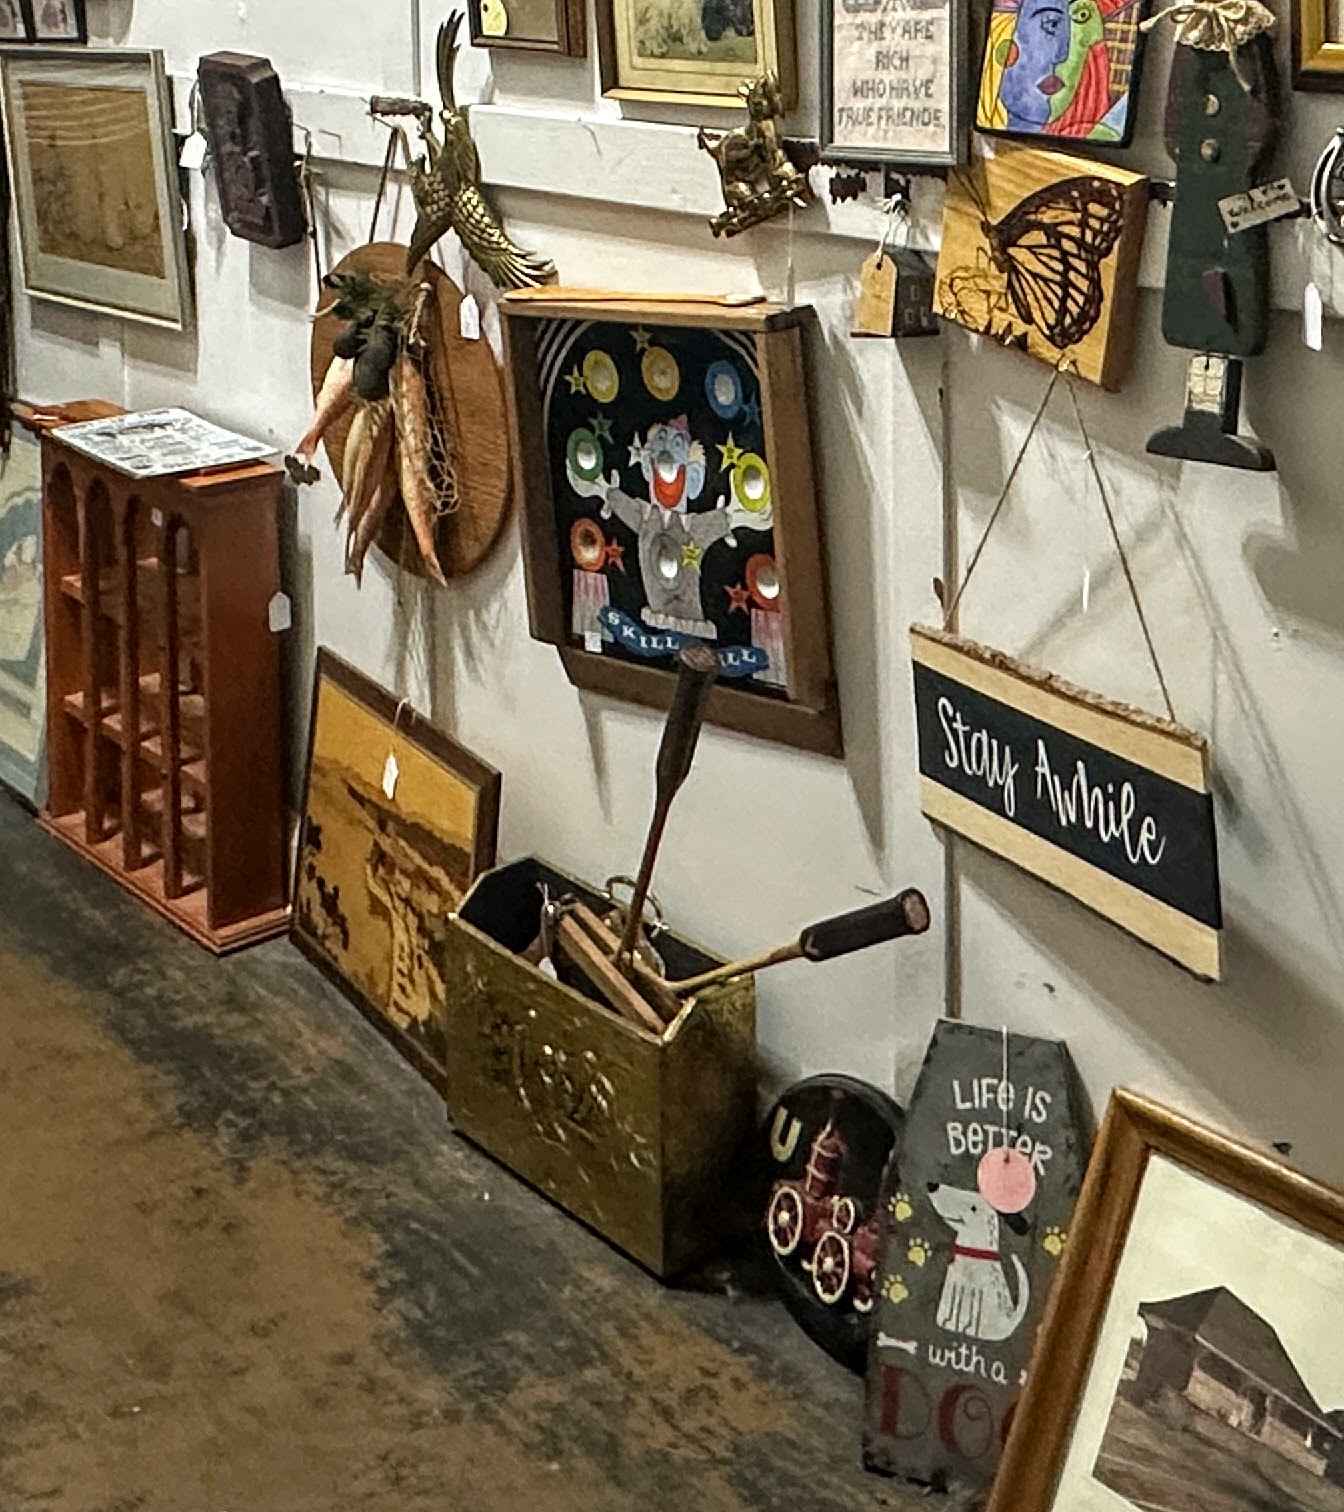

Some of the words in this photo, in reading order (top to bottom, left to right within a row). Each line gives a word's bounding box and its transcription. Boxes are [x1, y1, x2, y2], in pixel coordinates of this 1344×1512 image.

[854, 18, 899, 41] THEY
[901, 18, 934, 41] ARE
[874, 50, 911, 71] RICH
[851, 78, 887, 100] WHO
[888, 78, 935, 100] HAVE
[836, 106, 875, 128] TRUE
[607, 611, 680, 650] SKILL
[937, 696, 1020, 818] Stay
[1034, 738, 1167, 865] Awhile
[1023, 1086, 1052, 1124] IS
[928, 1342, 988, 1379] with
[990, 1360, 1008, 1385] a
